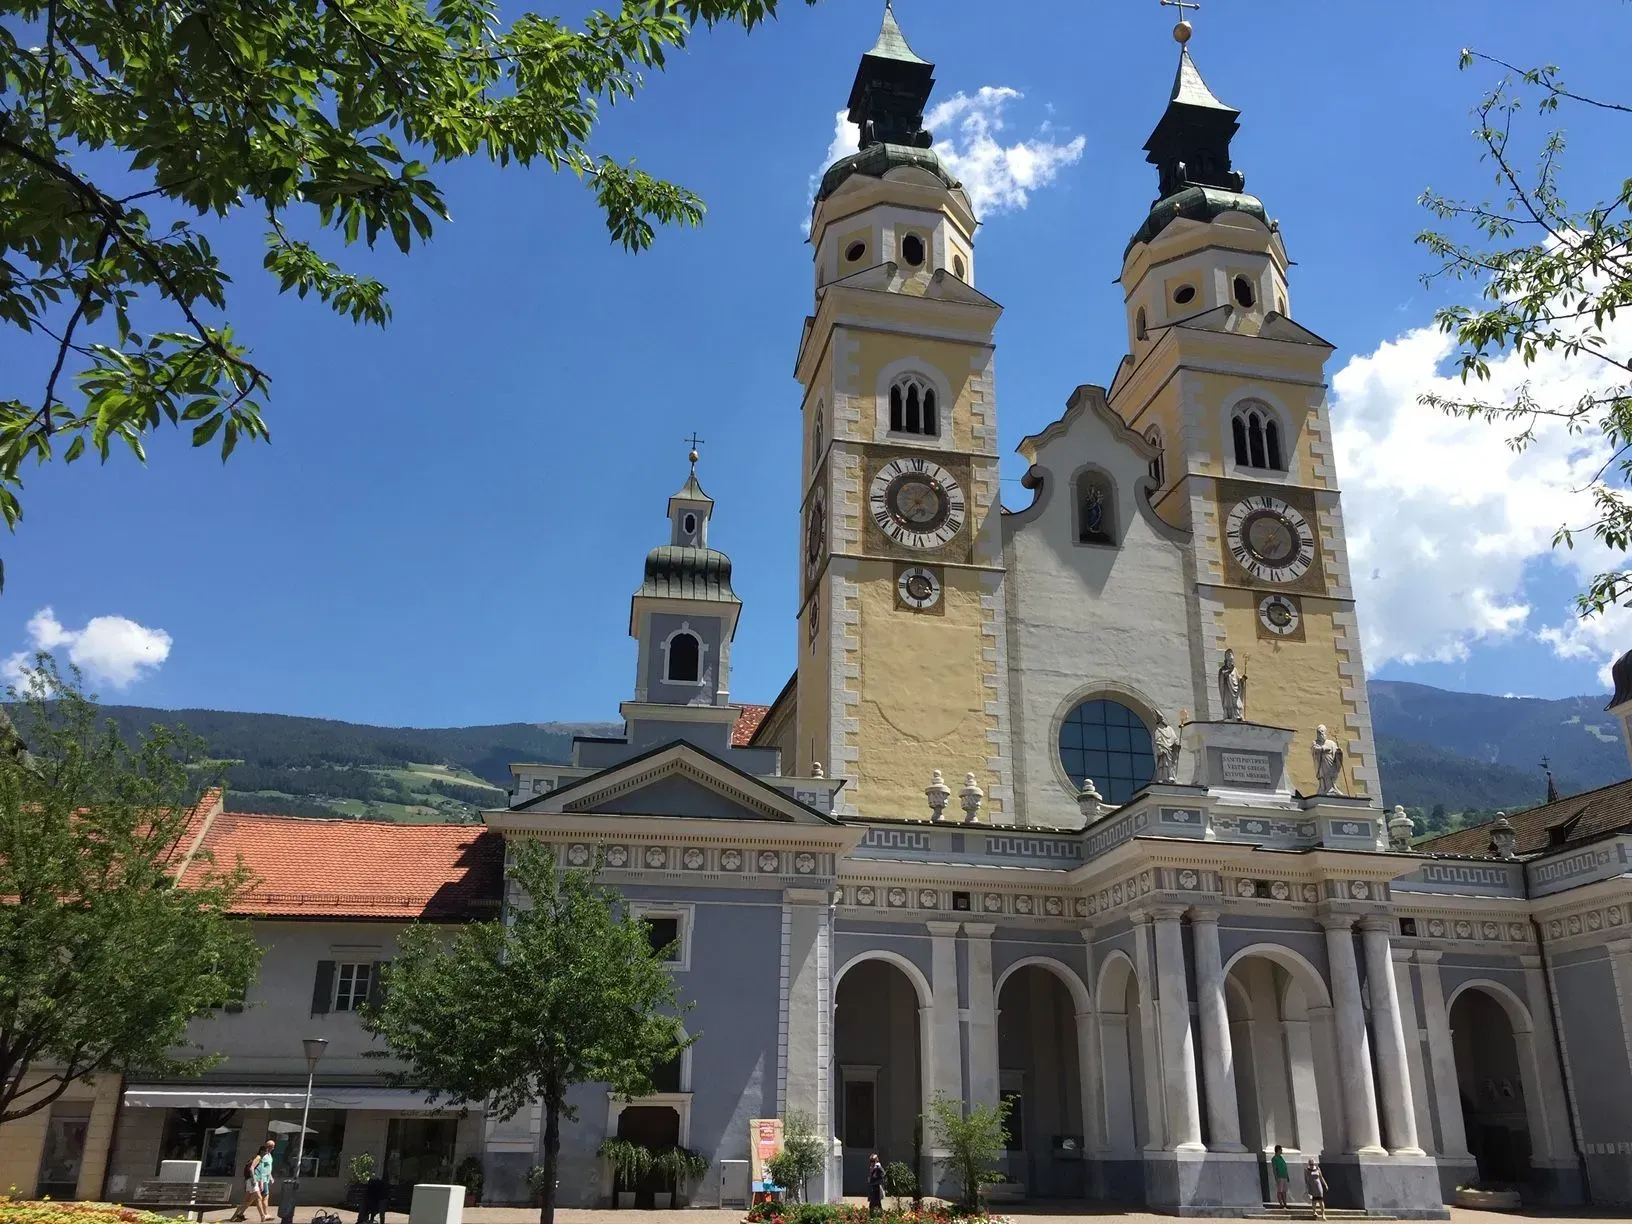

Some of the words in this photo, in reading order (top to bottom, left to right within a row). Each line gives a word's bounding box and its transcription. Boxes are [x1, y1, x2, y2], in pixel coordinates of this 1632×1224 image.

[911, 458, 924, 471] XII
[933, 467, 941, 477] I
[946, 482, 959, 492] II
[951, 502, 964, 512] III
[874, 511, 888, 529] VIII
[946, 518, 961, 533] IIII
[890, 526, 904, 542] VII
[913, 534, 925, 547] VI
